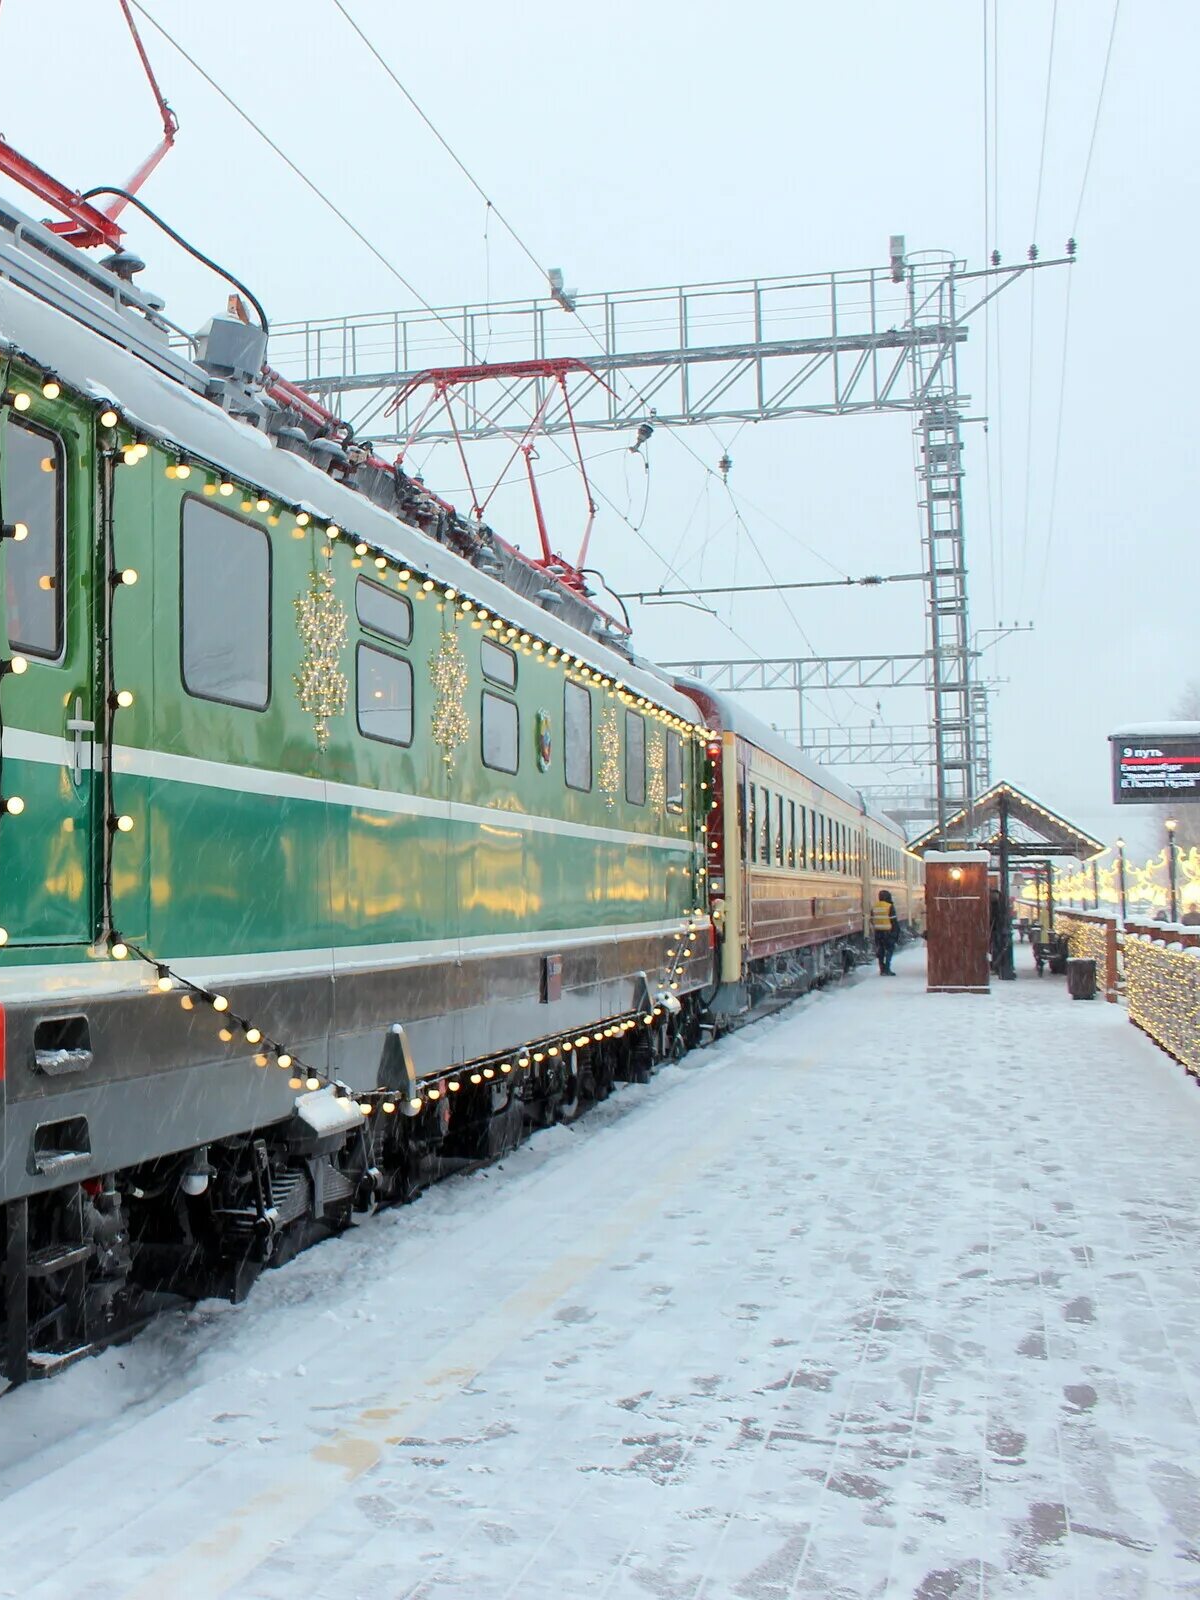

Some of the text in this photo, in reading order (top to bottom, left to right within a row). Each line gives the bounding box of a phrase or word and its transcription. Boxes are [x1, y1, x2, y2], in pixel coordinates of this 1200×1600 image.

[1123, 748, 1164, 759] 9 путь
[1165, 780, 1195, 788] Музей
